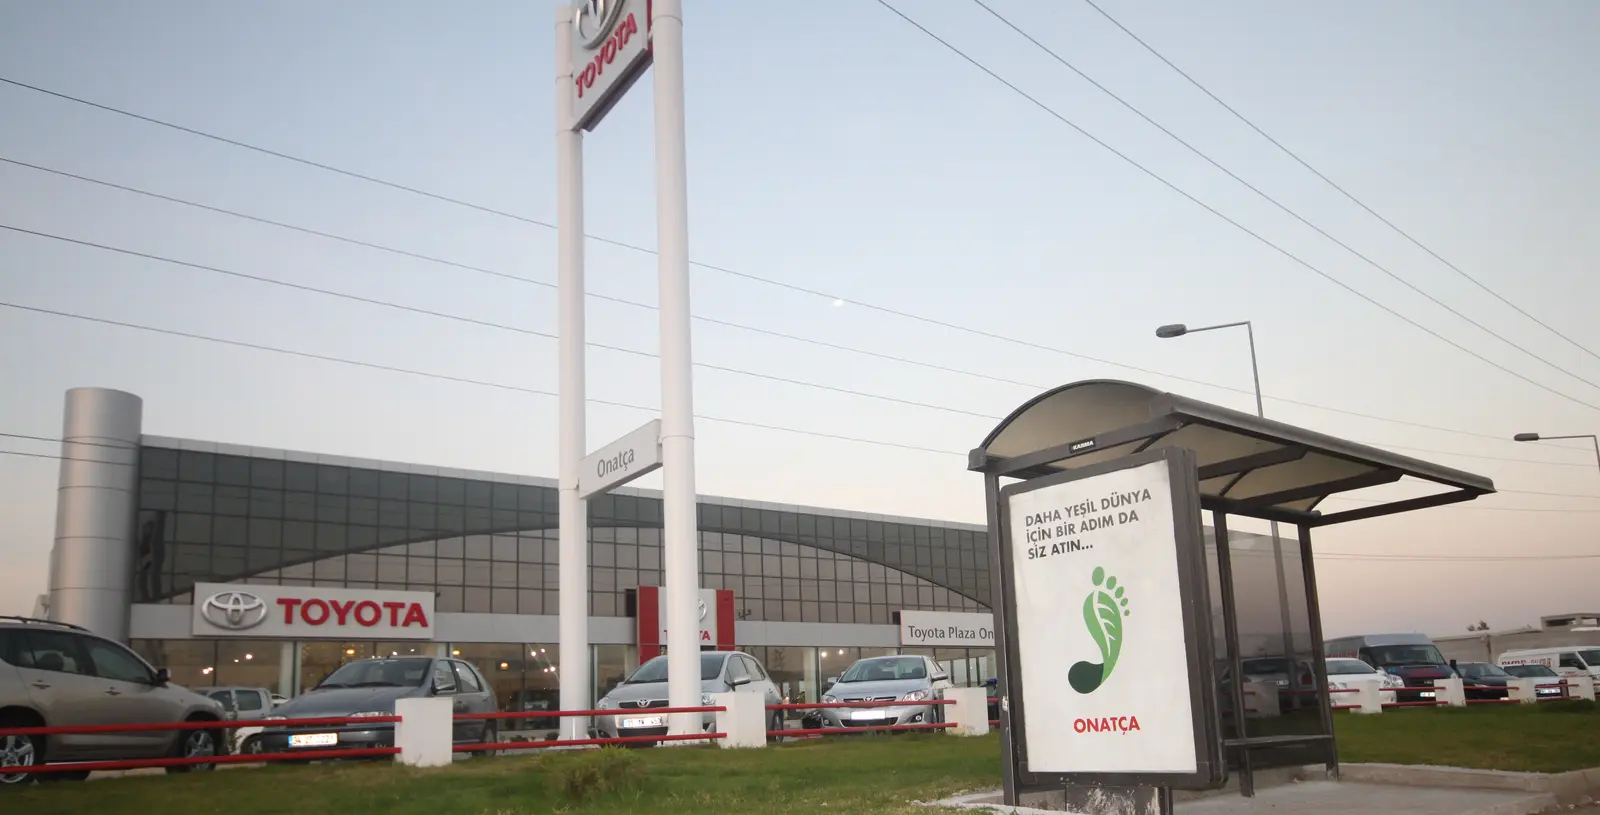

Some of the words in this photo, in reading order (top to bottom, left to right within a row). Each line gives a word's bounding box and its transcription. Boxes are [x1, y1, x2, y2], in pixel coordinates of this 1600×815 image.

[575, 13, 638, 98] TOYOTA
[597, 448, 635, 478] Onatça
[1025, 509, 1062, 527] DAHA
[1065, 498, 1097, 518] YEŞİL
[1101, 488, 1152, 510] DÜNYA
[1026, 526, 1052, 545] İÇİN
[1056, 521, 1076, 538] BİR
[1080, 514, 1114, 533] ADIM
[1118, 509, 1139, 525] DA
[1028, 544, 1047, 560] SİZ
[1051, 539, 1094, 556] ATIN...
[276, 597, 428, 627] TOYOTA
[908, 625, 945, 642] Toyota
[948, 626, 976, 639] Plaza
[1073, 716, 1141, 735] ONATÇA
